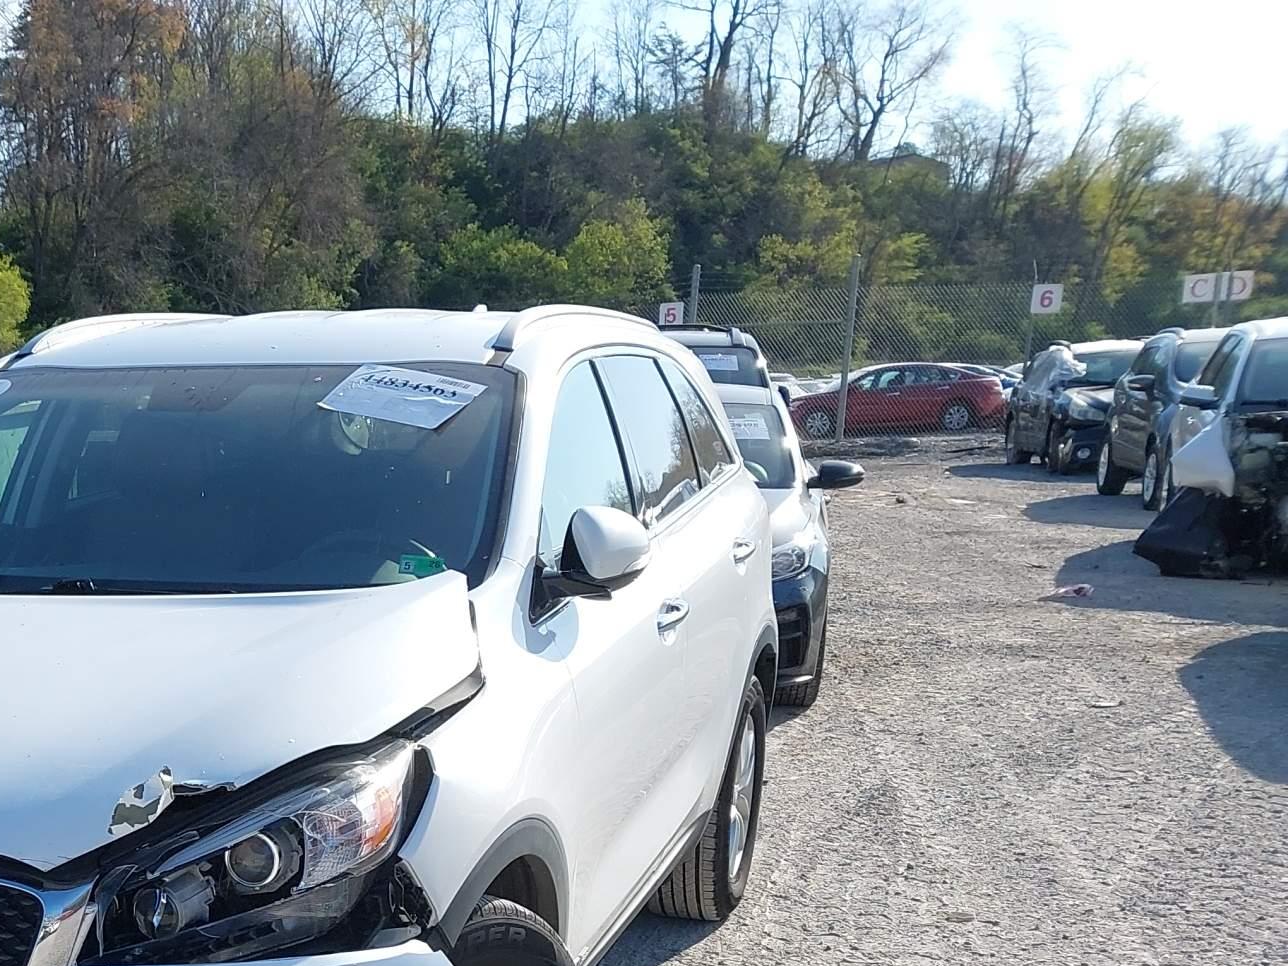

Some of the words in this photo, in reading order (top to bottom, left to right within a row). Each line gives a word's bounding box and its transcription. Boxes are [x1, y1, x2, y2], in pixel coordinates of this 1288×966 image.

[1191, 278, 1209, 298] C
[1039, 290, 1054, 308] 6
[666, 307, 677, 324] 5
[404, 561, 411, 570] 5
